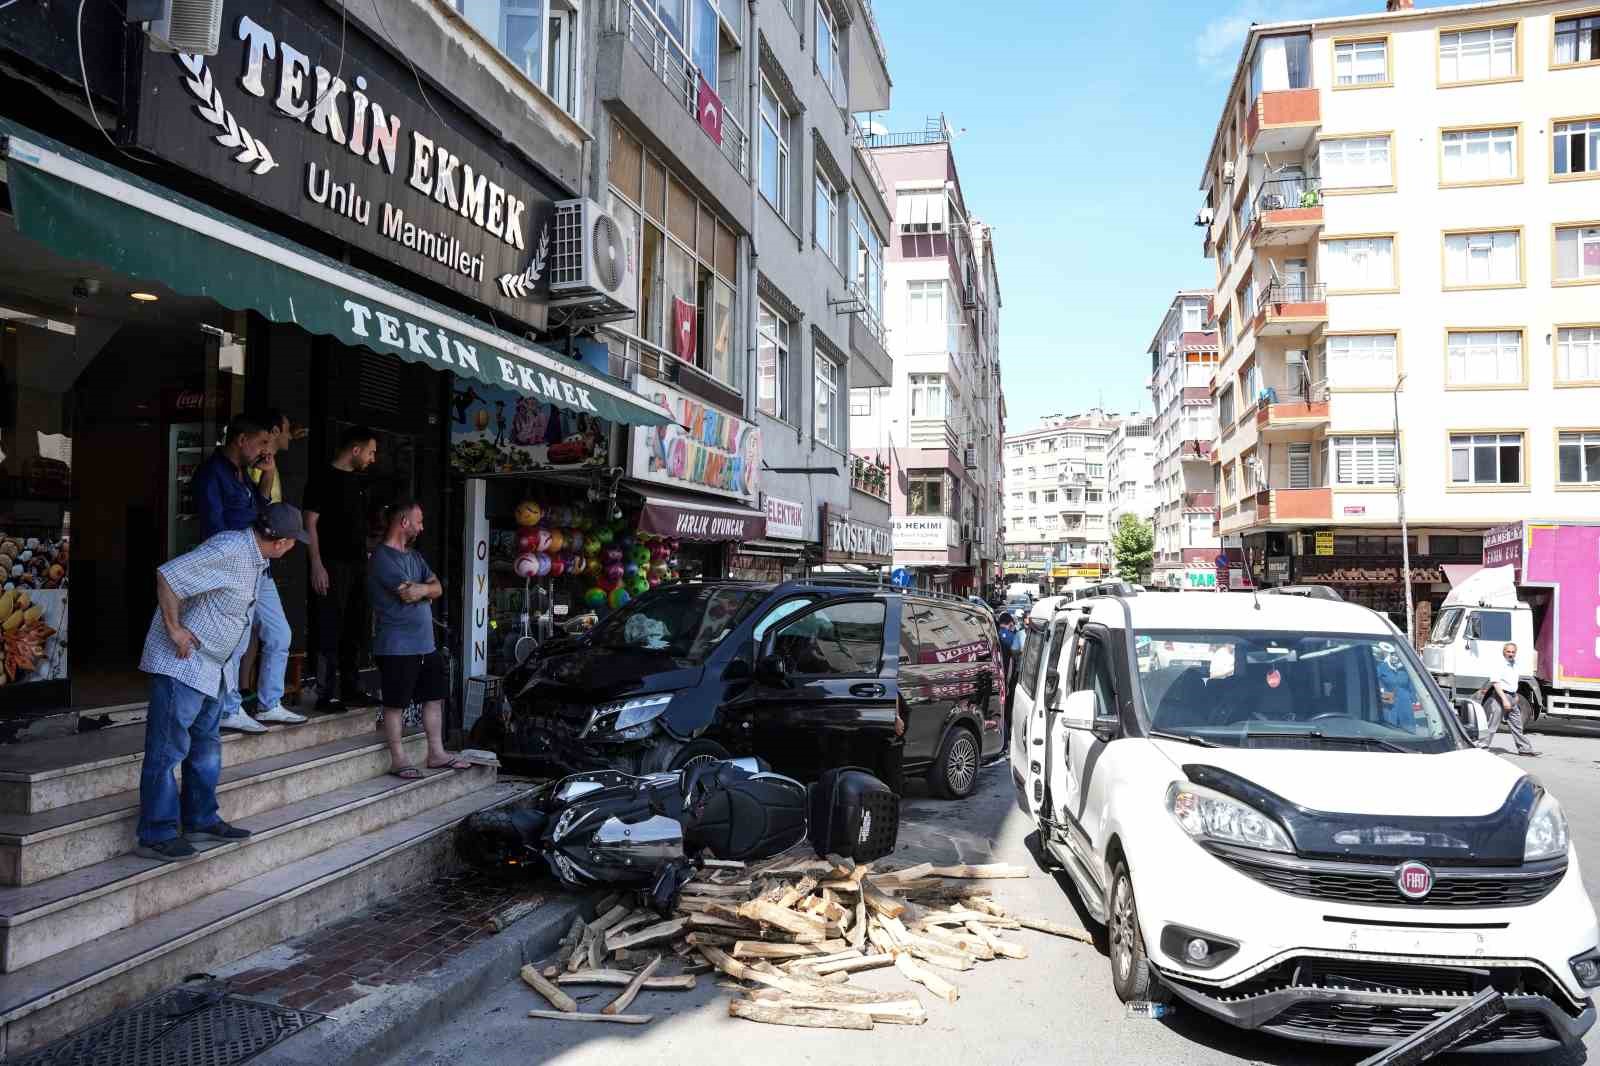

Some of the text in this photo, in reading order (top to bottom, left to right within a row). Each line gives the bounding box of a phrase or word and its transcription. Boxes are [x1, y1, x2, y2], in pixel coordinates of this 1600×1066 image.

[239, 15, 526, 250] TEKİN EKMEK
[308, 161, 485, 282] Unlu Mamülleri
[344, 300, 598, 411] TEKİN EKMEK
[676, 513, 744, 536] VARLIK OYUNCAK
[475, 540, 487, 662] OYUN
[1406, 871, 1425, 889] FIAT
